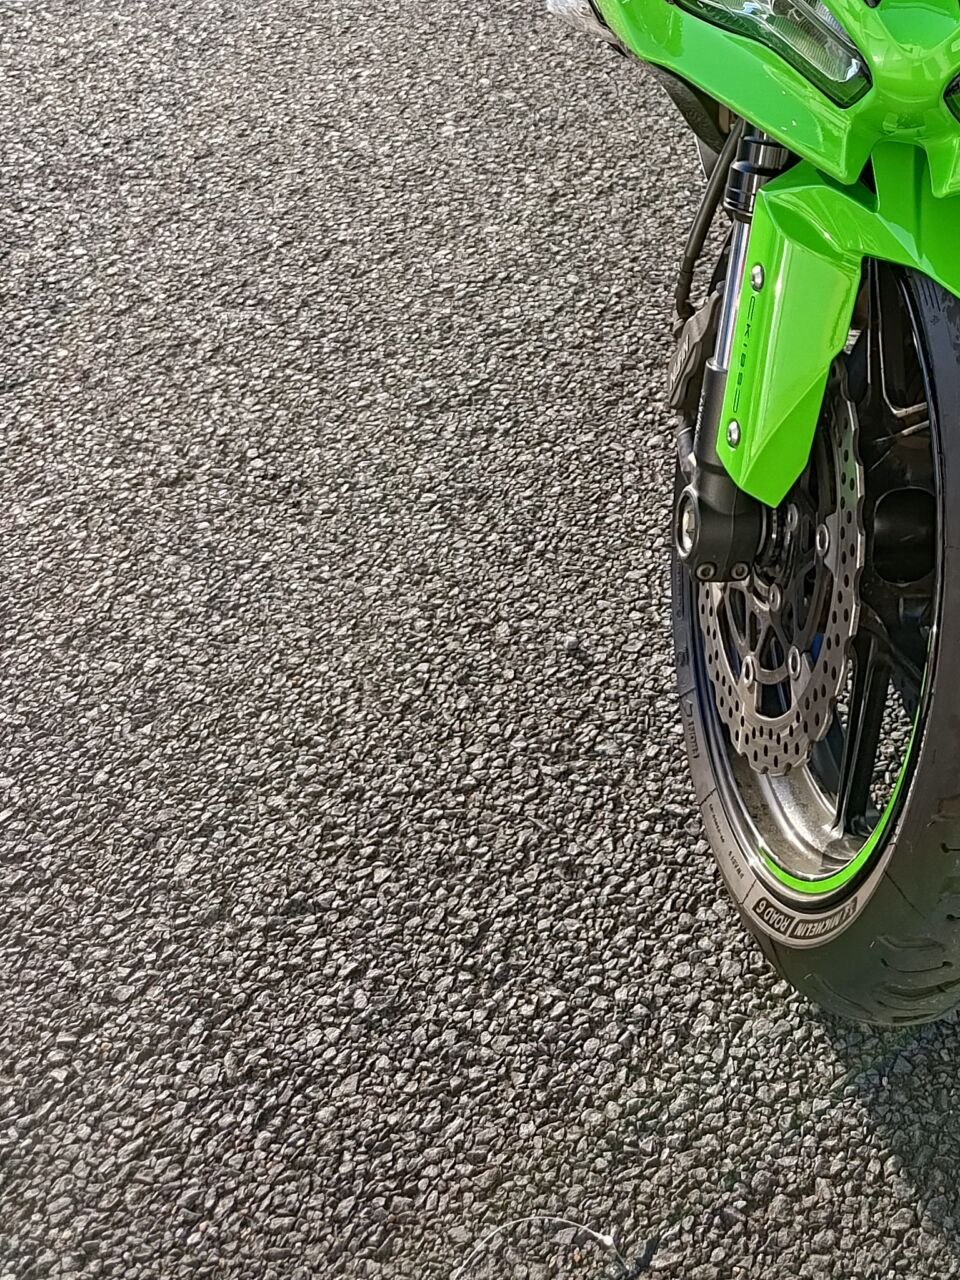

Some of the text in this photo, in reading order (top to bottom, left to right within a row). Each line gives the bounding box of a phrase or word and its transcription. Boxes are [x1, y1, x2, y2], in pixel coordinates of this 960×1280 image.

[755, 900, 843, 937] MICHELIN ROAD 6
